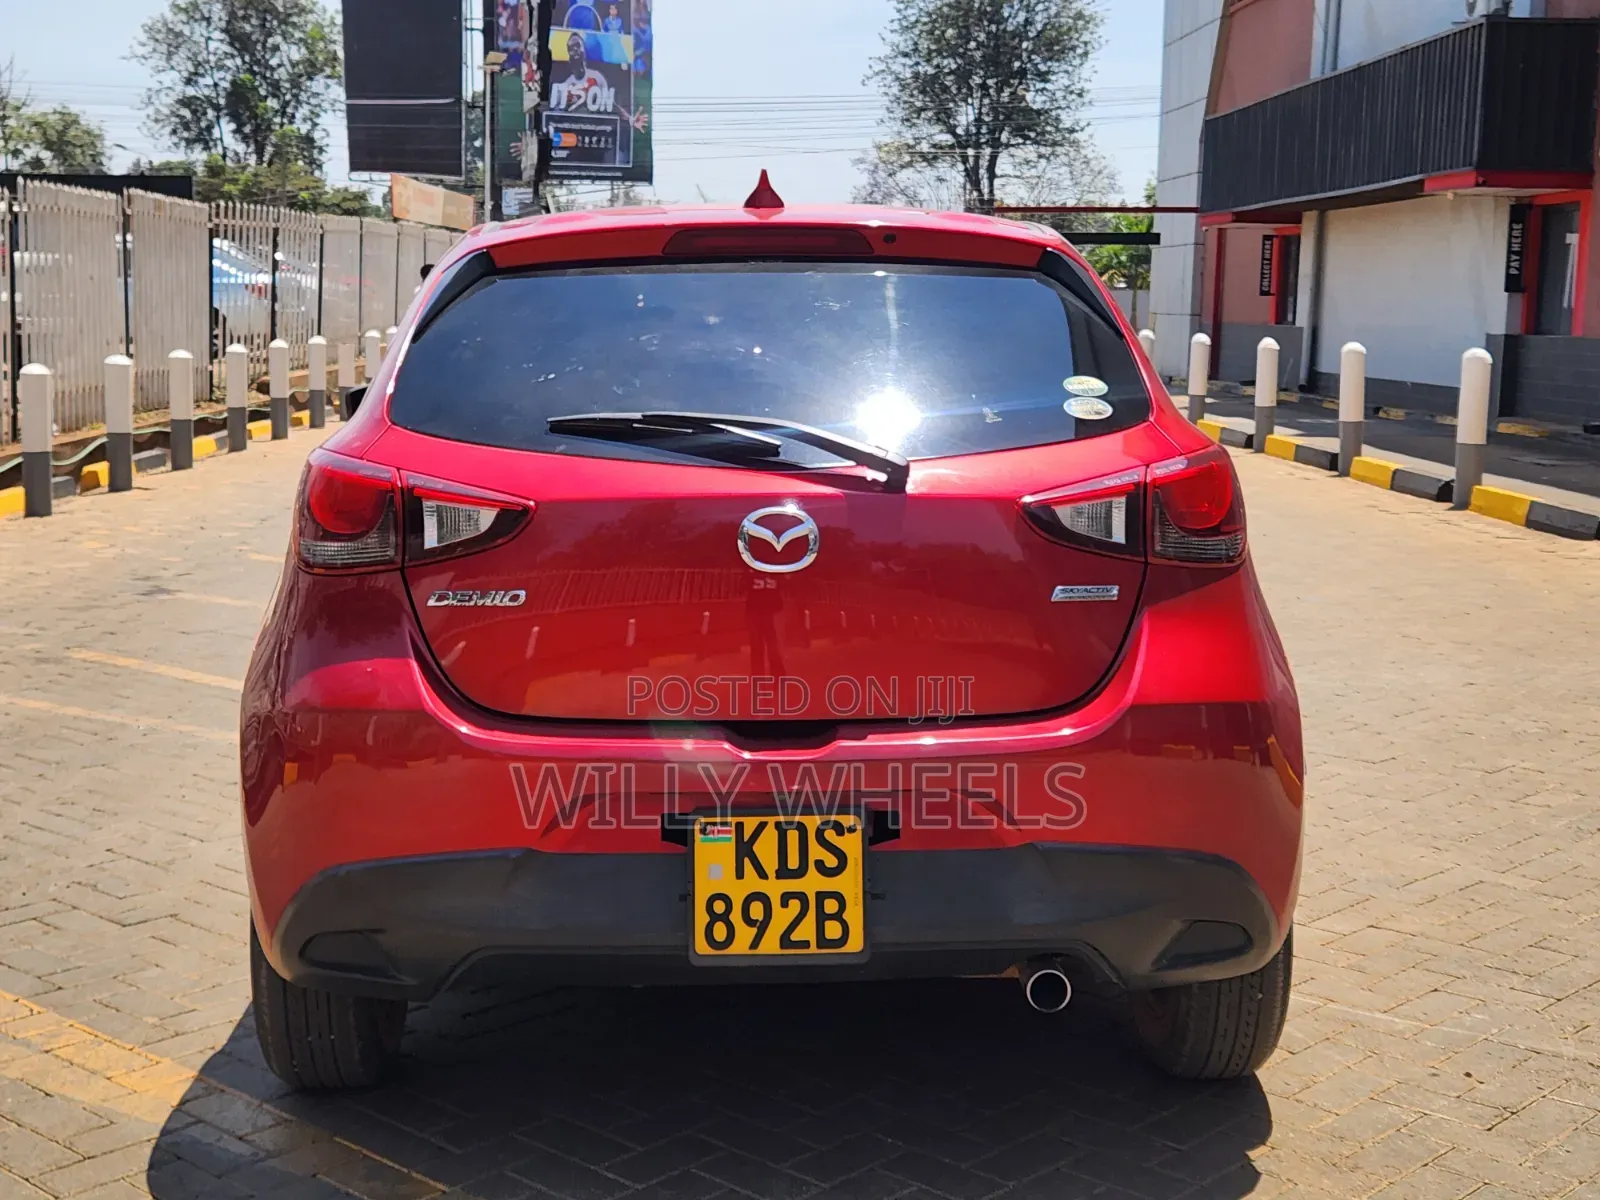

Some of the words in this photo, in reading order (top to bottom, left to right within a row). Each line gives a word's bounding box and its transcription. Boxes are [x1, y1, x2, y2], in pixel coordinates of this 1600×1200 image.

[1263, 240, 1272, 259] HERE
[1511, 223, 1524, 251] HERE
[1261, 259, 1271, 291] COLLECT
[1508, 253, 1521, 275] PAY
[426, 589, 527, 607] DEMIO
[734, 821, 848, 881] KDS
[703, 890, 850, 950] 892B
